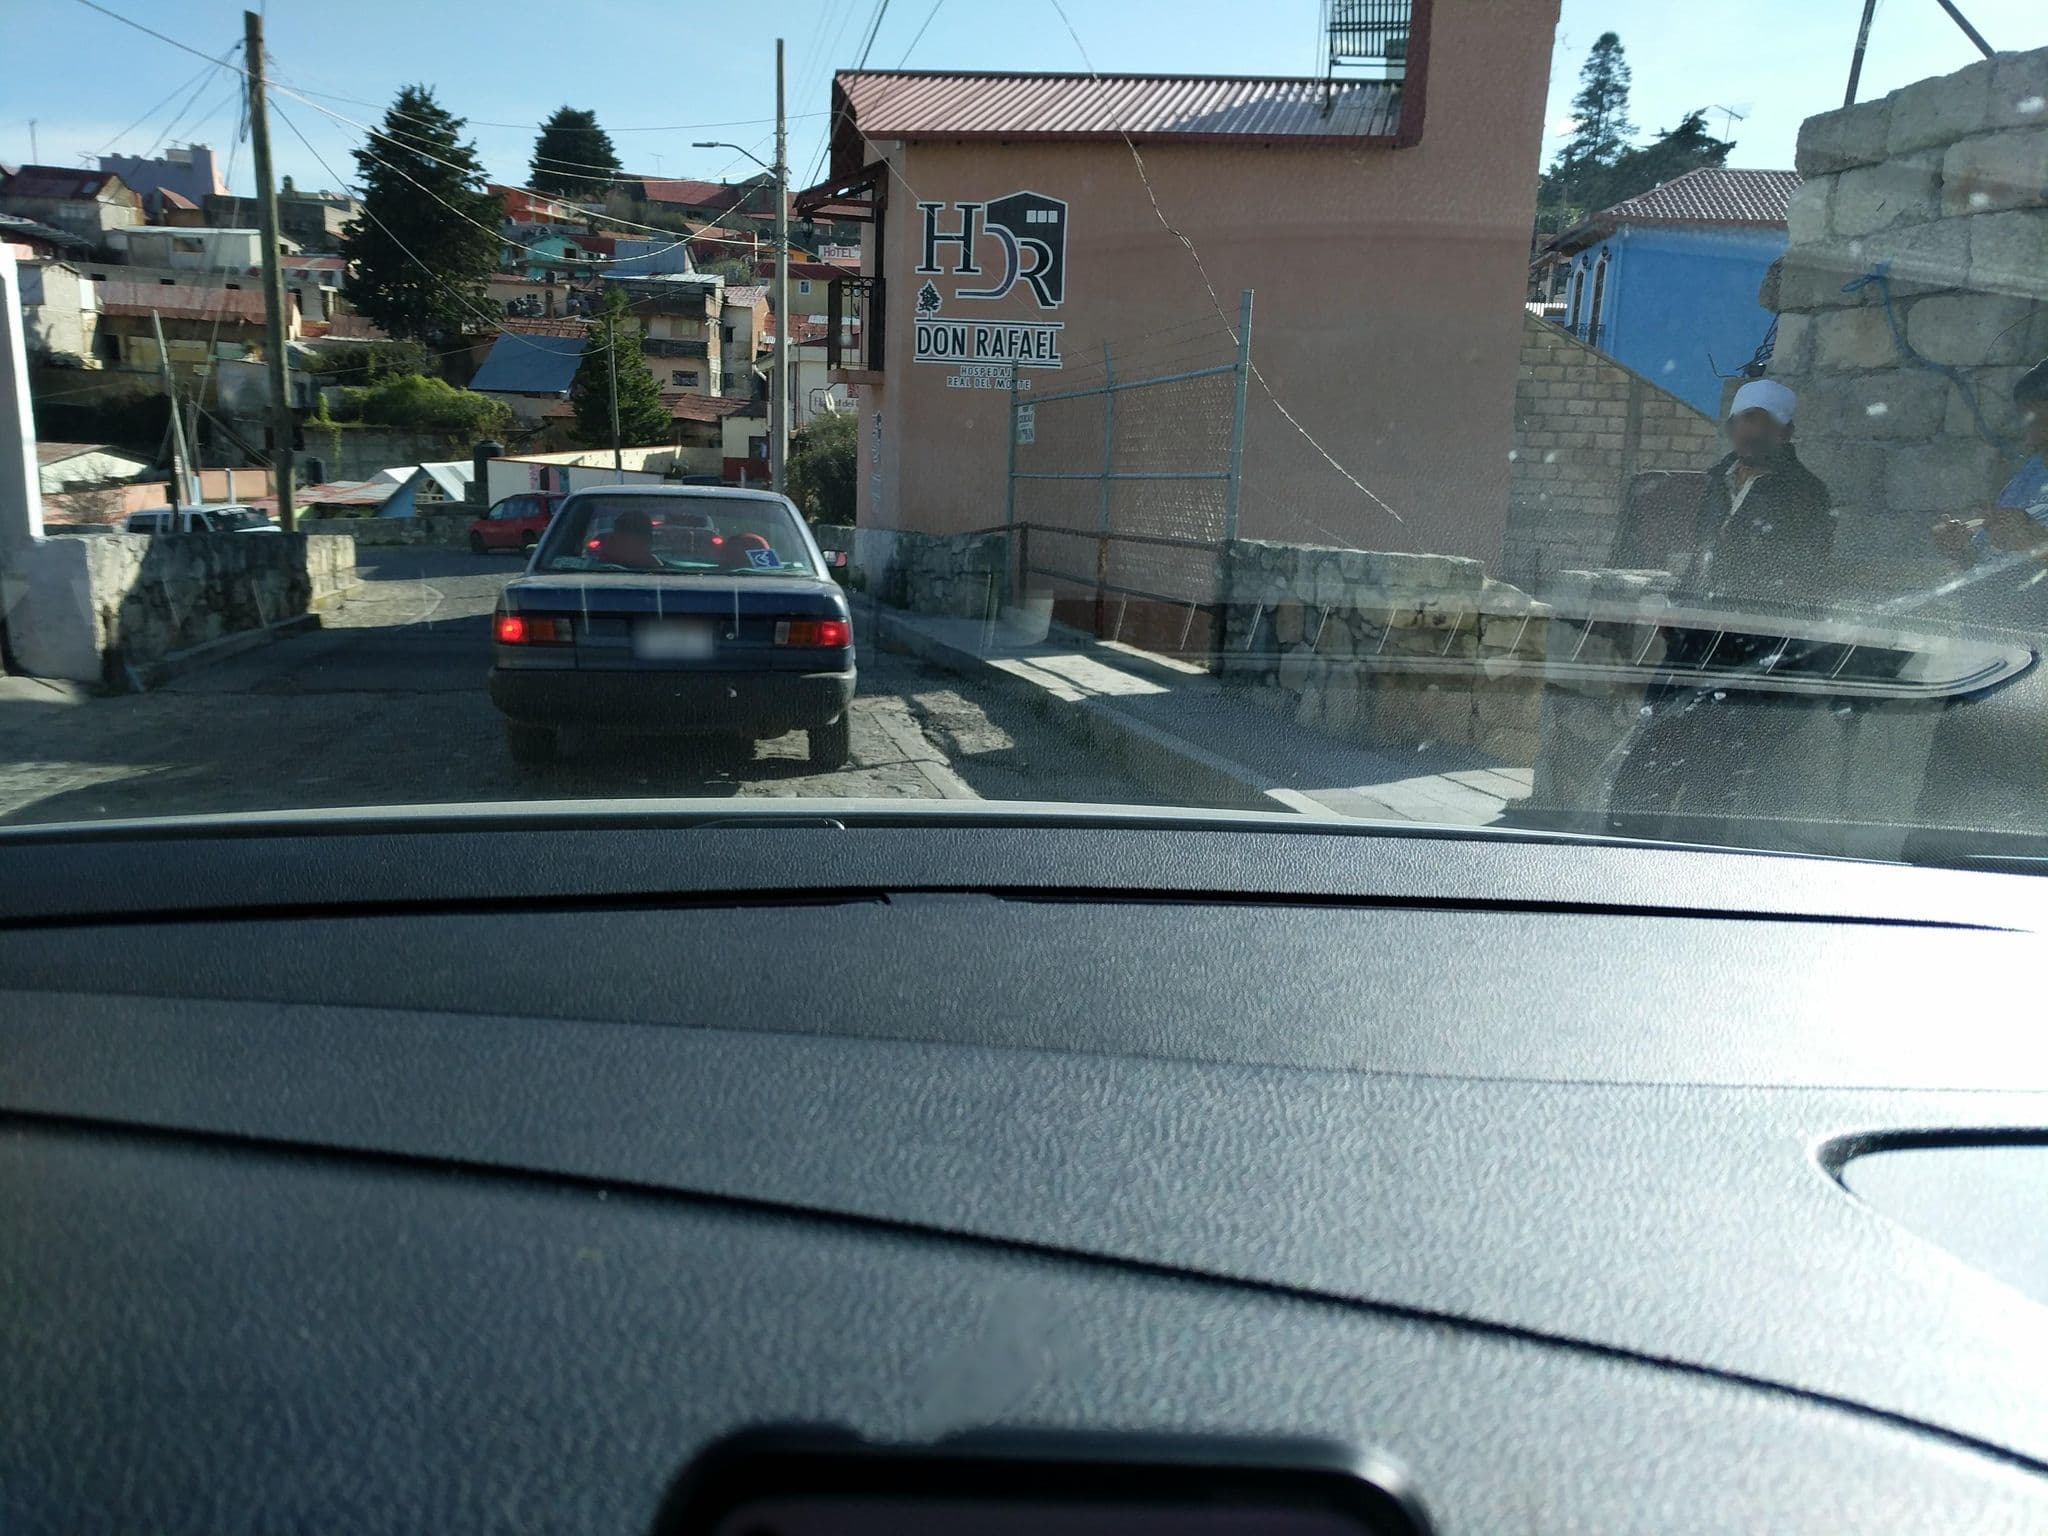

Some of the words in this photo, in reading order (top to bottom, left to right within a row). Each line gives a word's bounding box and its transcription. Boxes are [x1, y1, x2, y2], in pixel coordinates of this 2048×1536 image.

[823, 247, 855, 258] HOTEL
[915, 324, 967, 357] DON
[973, 326, 1062, 362] RAFAEL
[960, 365, 1013, 378] HOSPEDAJ
[946, 376, 971, 388] REAL
[974, 377, 992, 389] DEL
[994, 378, 1031, 390] MOTE
